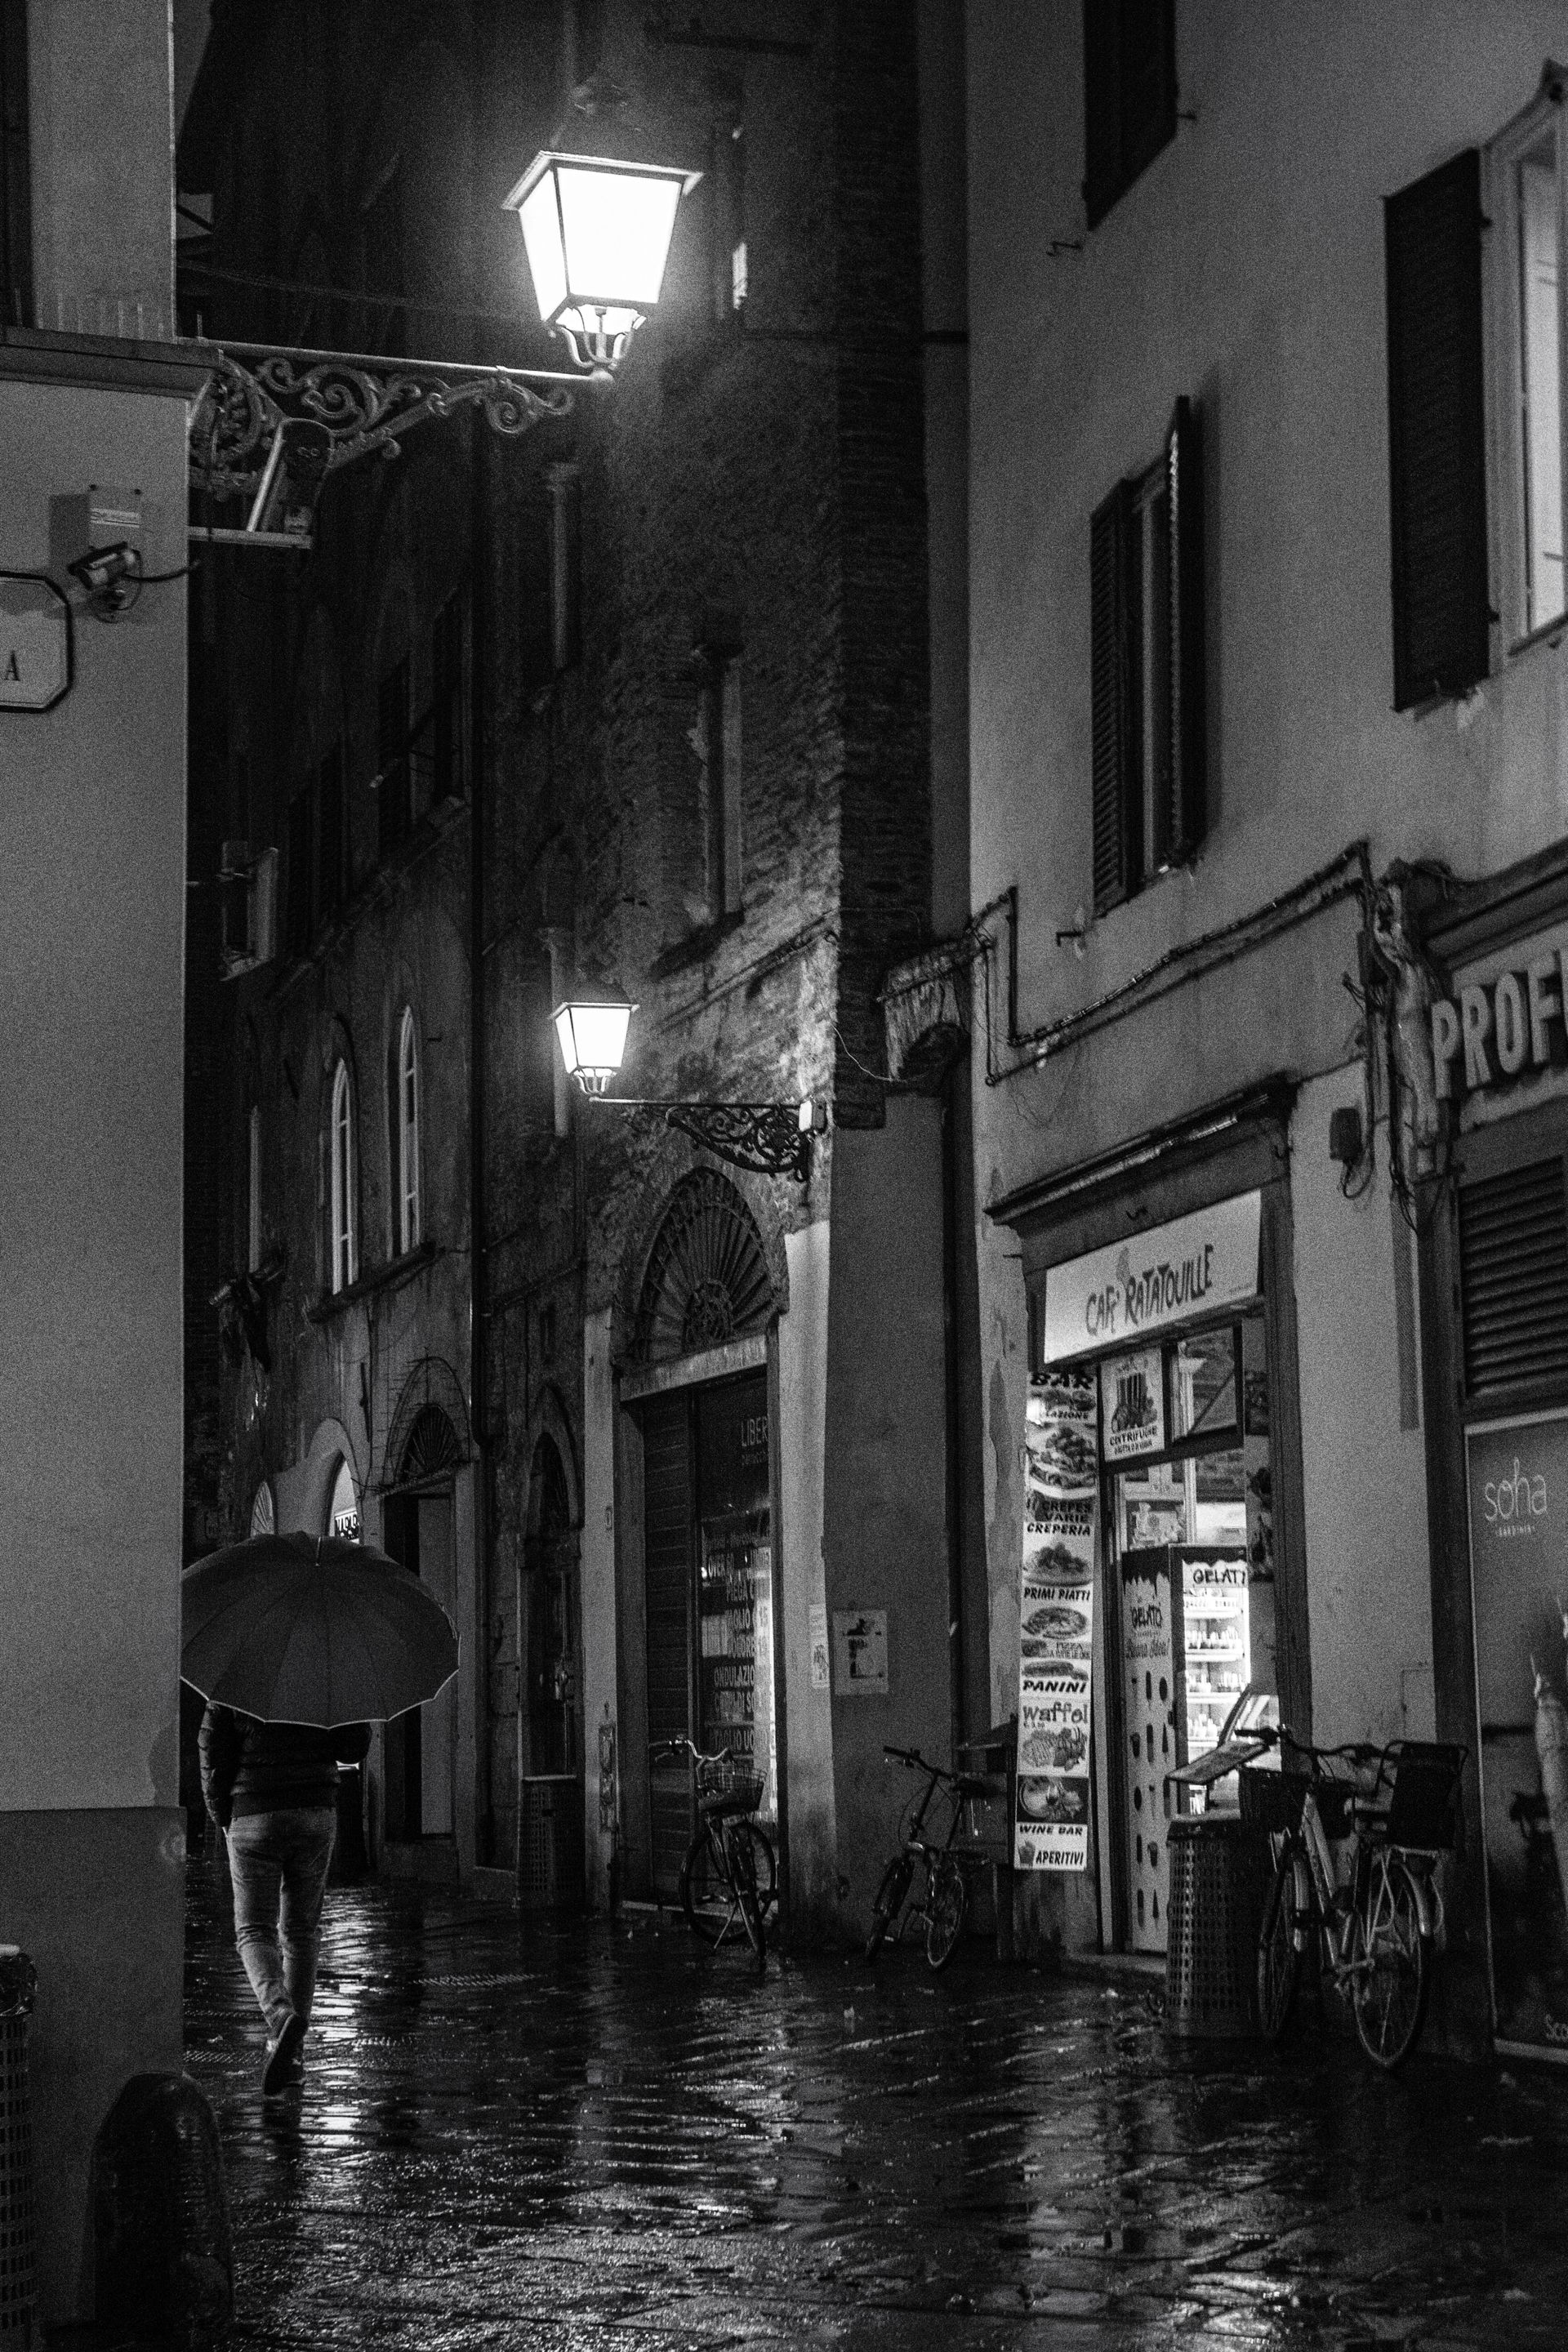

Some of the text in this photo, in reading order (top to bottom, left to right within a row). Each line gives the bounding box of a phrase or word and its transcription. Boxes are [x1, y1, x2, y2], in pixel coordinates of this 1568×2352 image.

[1125, 1244, 1214, 1325] RATATOUILLE
[1030, 1372, 1094, 1390] BAR
[1484, 1456, 1548, 1522] soha
[1027, 1522, 1092, 1537] CREPERIA
[1022, 1585, 1092, 1602] PRIMI PIATTI
[1022, 1679, 1088, 1694] PANINI
[1018, 1824, 1085, 1836] WINE BAR
[1036, 1850, 1085, 1866] APERITIVI
